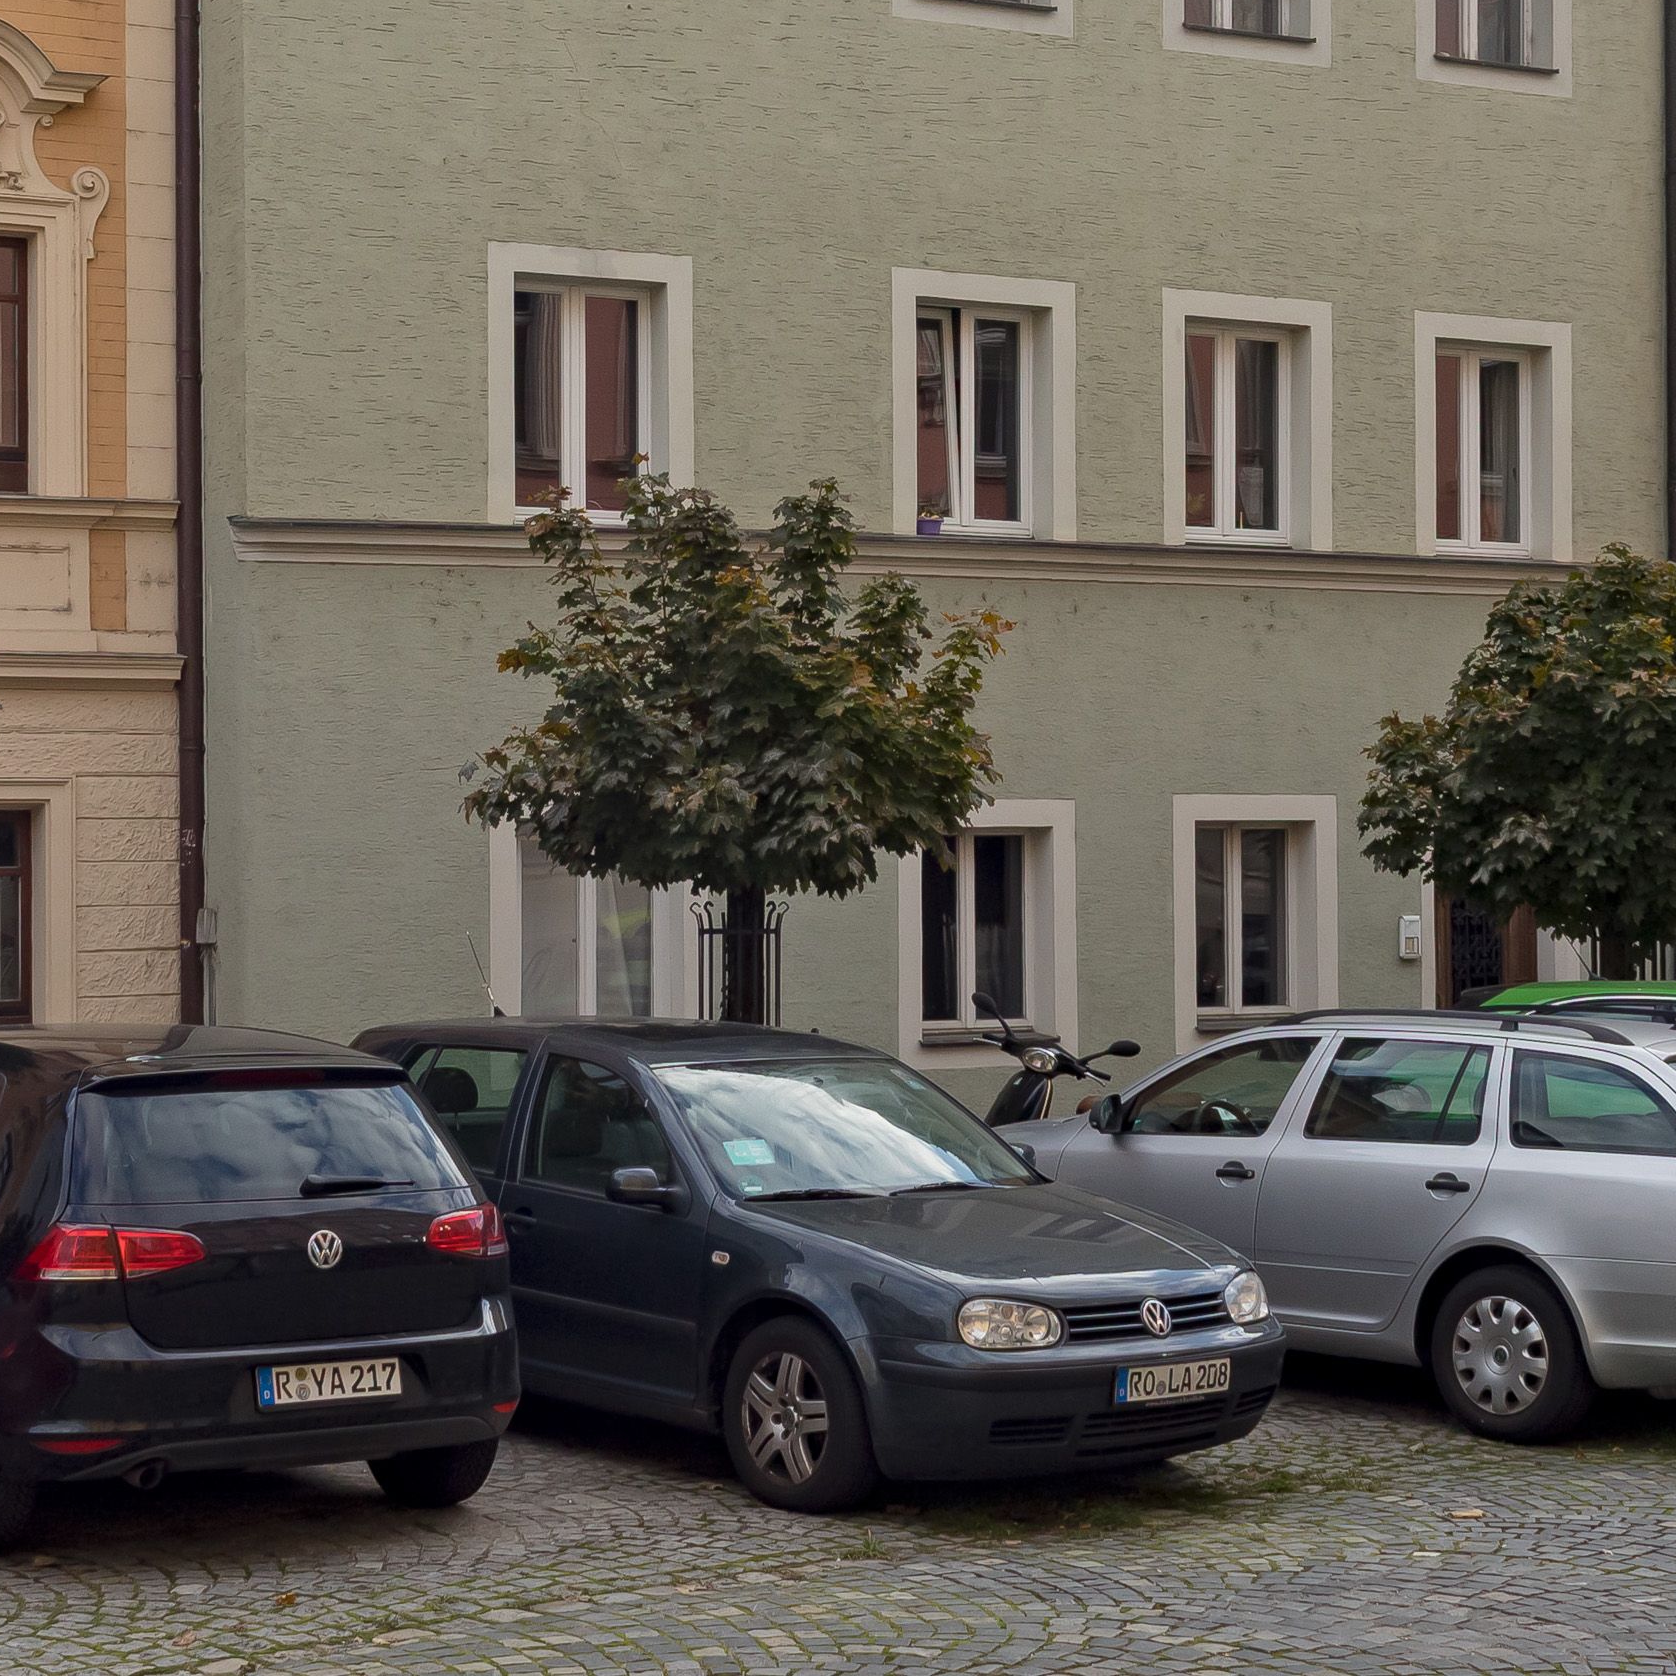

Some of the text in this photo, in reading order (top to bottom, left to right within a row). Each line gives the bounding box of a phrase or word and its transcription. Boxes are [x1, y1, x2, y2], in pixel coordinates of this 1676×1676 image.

[275, 1361, 397, 1400] R YA 217
[1129, 1362, 1228, 1398] RO LA 208
